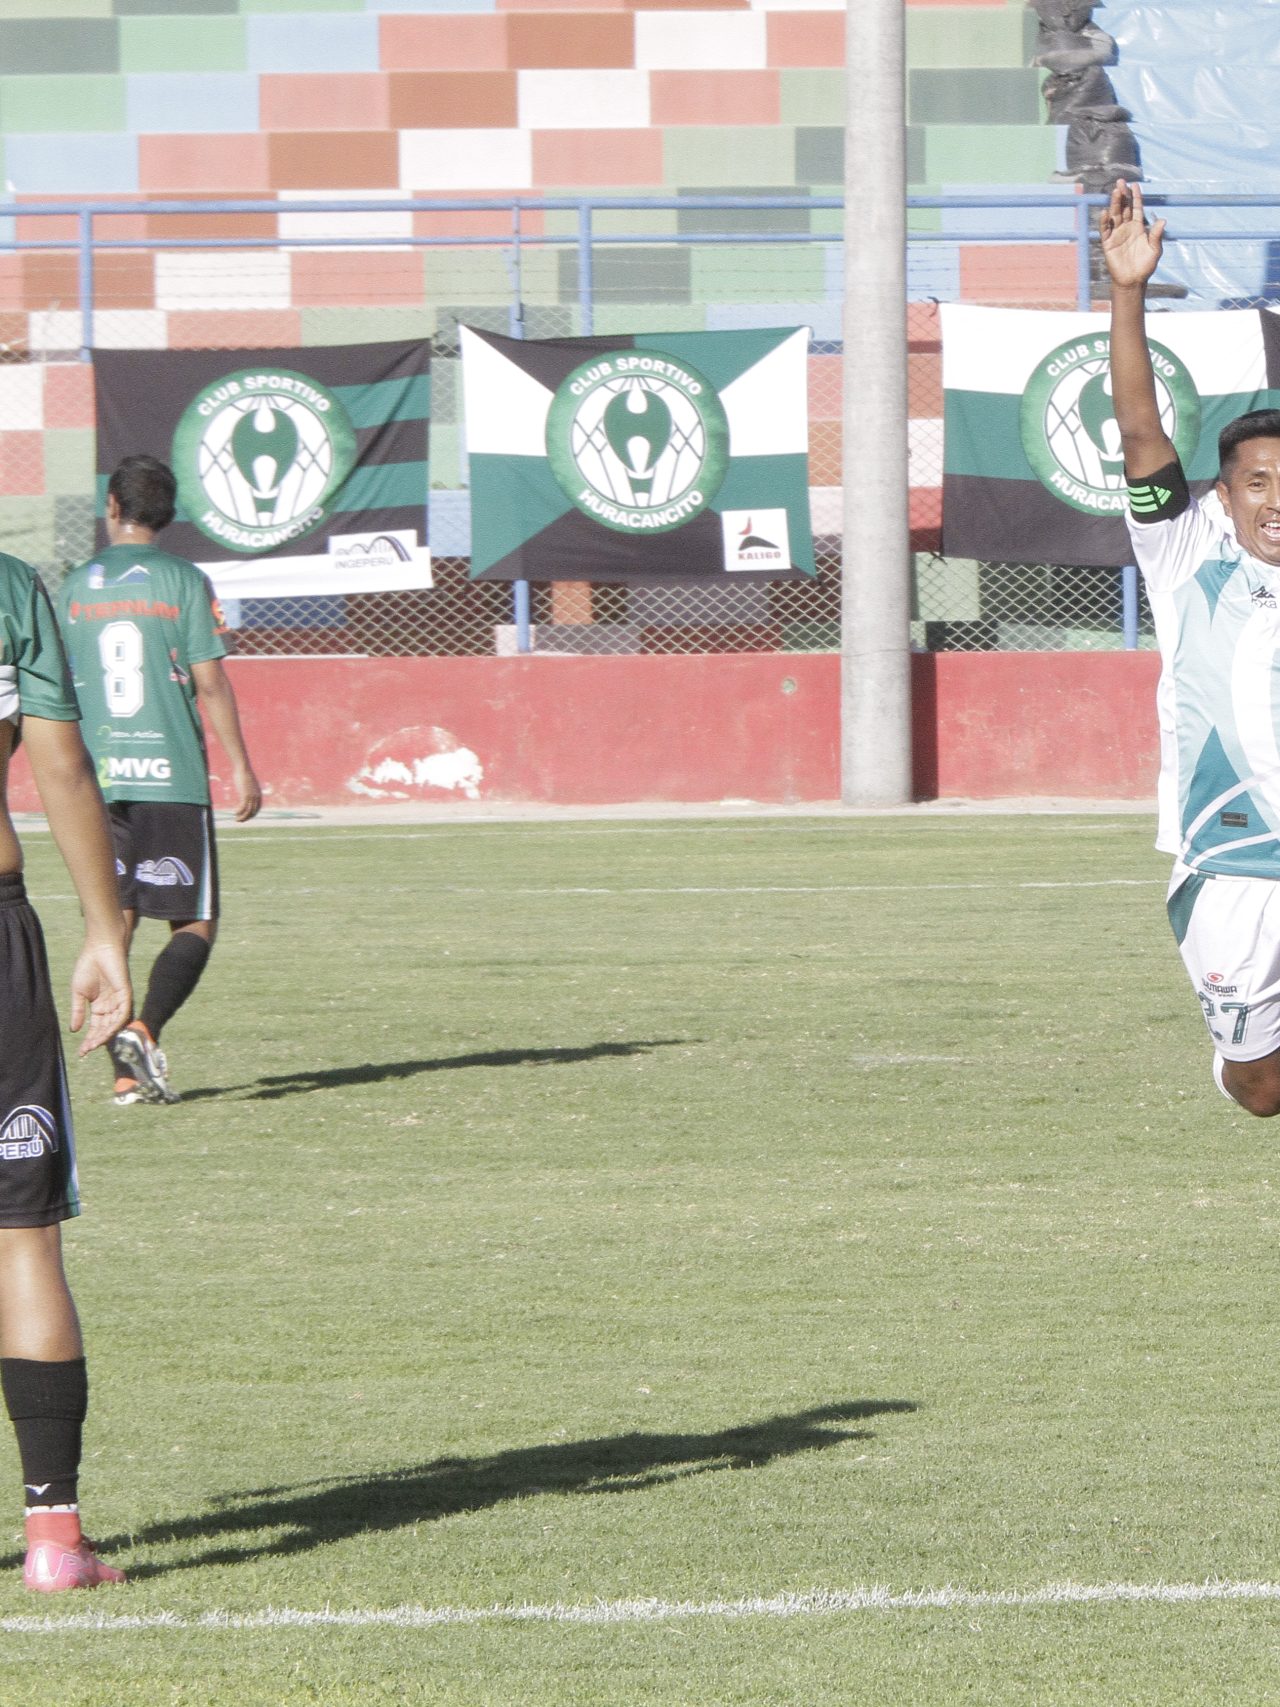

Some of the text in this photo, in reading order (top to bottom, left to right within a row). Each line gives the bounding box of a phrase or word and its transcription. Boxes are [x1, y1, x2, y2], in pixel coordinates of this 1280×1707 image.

[569, 357, 702, 397] CLUB SPORTIVO
[1047, 344, 1089, 376] CLUB
[197, 375, 331, 416] CLUB SPORTIVO
[578, 489, 703, 528] HURACANCITO
[98, 620, 144, 718] 8
[108, 757, 171, 779] MVG
